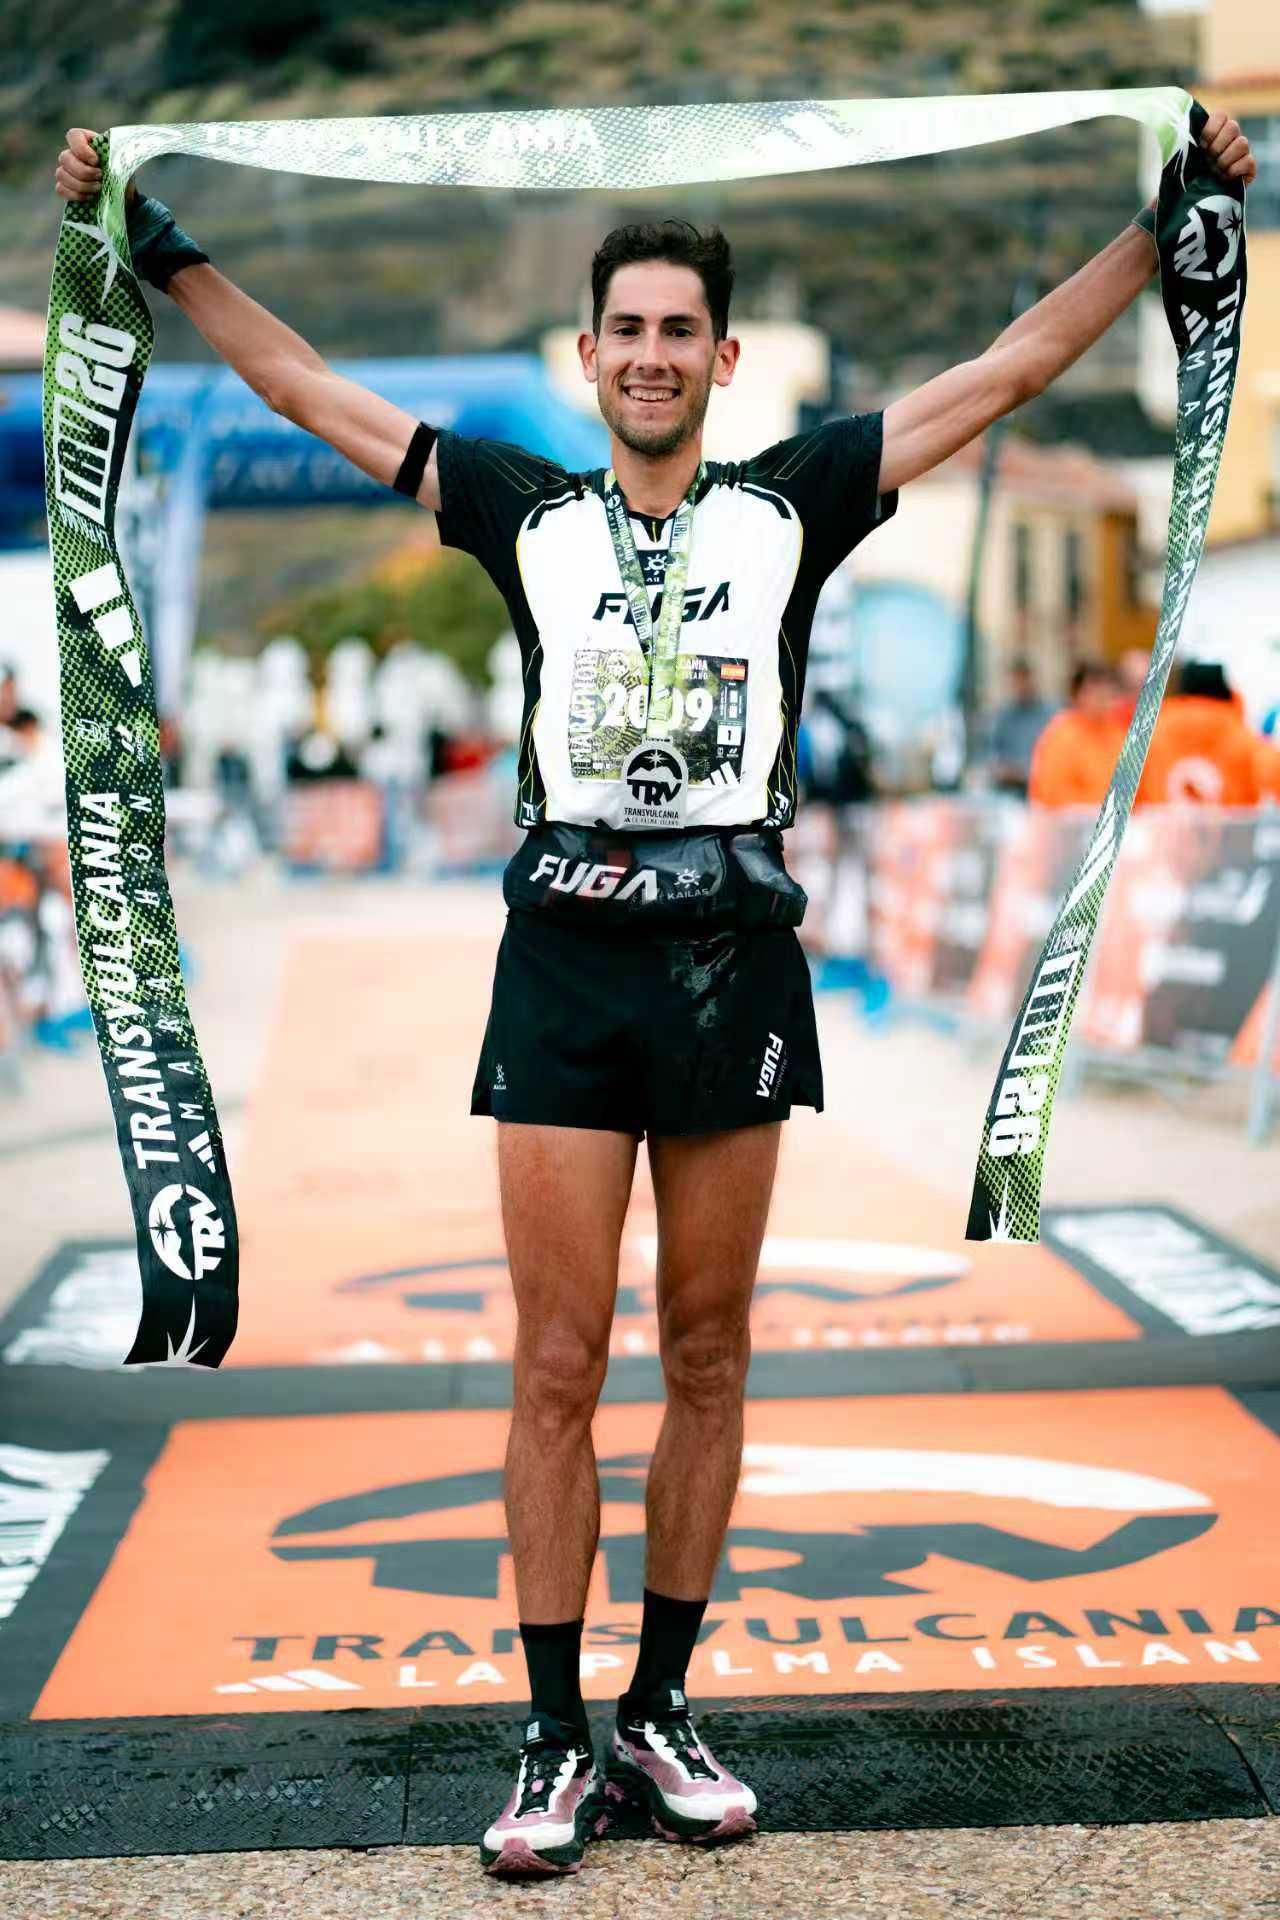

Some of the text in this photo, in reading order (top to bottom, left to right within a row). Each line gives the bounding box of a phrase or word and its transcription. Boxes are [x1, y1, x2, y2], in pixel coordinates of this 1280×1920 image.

[727, 730, 732, 741] 1
[624, 807, 679, 819] TRANSVULCANIA
[529, 854, 710, 901] FUGA KAILAS
[80, 792, 181, 1170] TRANSVULCANIA
[756, 1032, 783, 1098] FUGA
[398, 1661, 505, 1688] LA
[581, 1649, 904, 1678] PLMA
